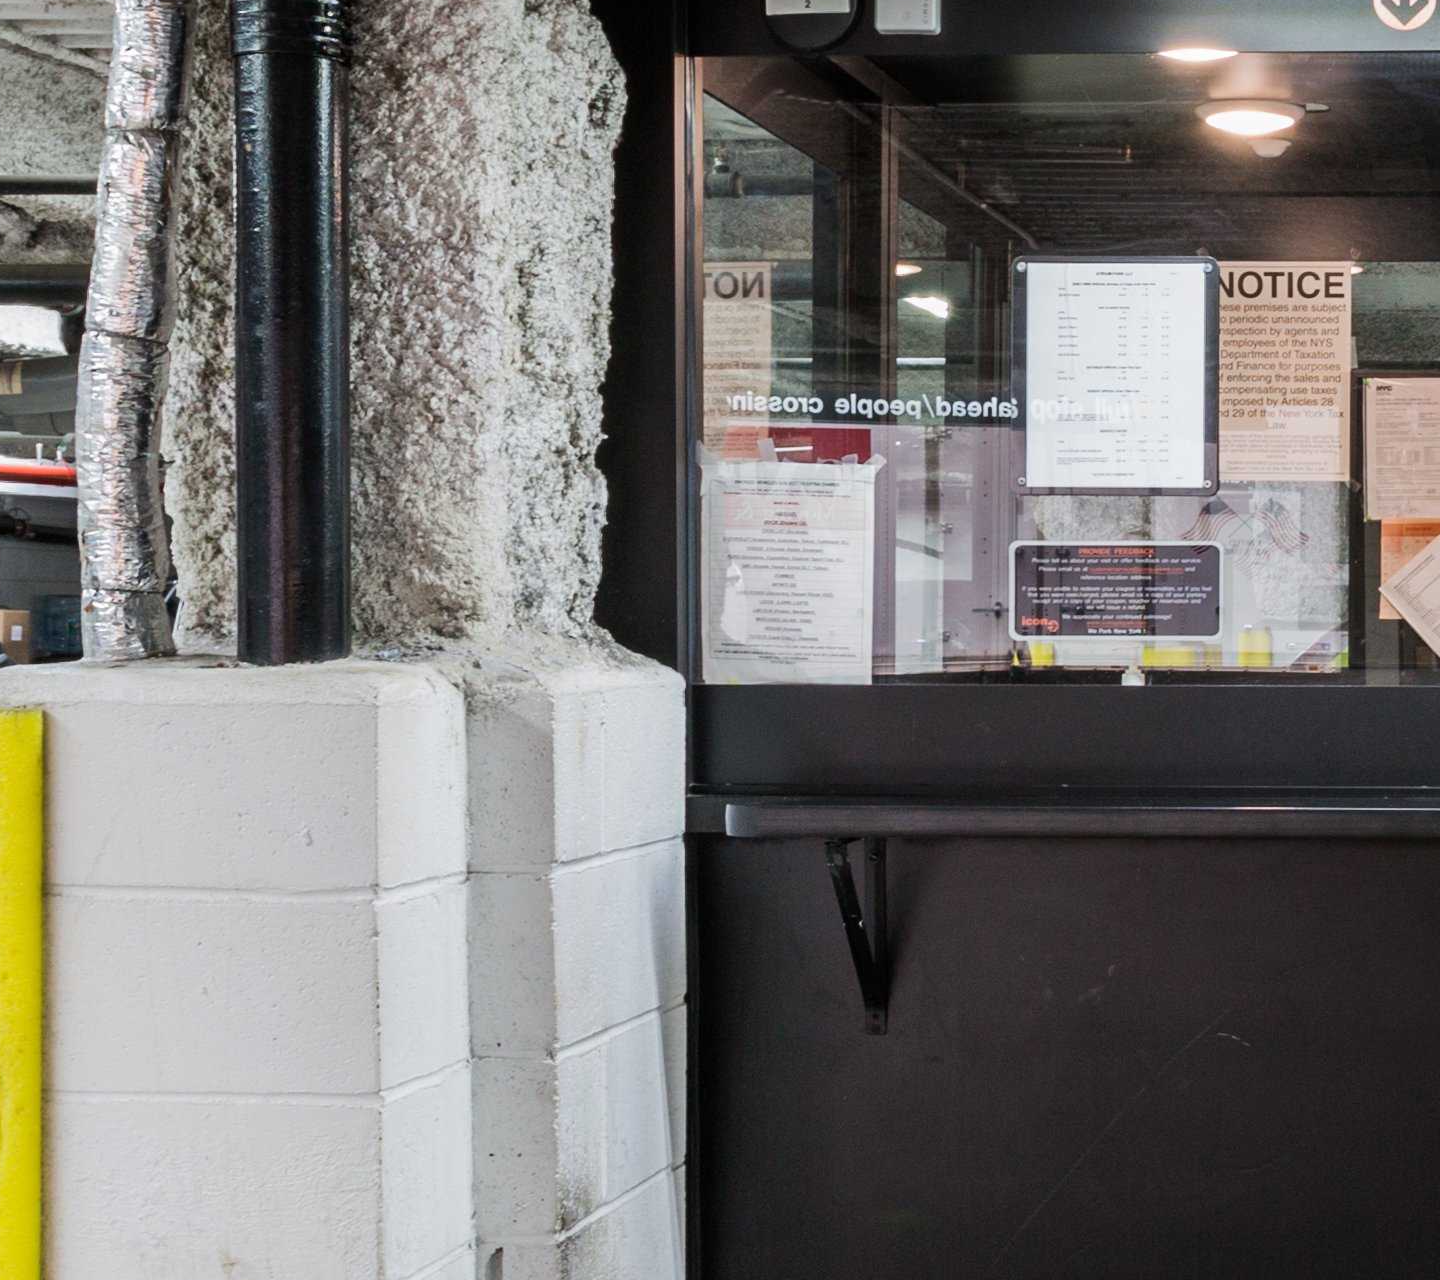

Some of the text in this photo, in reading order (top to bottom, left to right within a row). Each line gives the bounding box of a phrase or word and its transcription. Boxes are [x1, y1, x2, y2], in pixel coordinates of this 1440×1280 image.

[804, 0, 811, 8] 2
[1219, 271, 1345, 299] NOTICE
[1244, 304, 1288, 313] premises
[1311, 304, 1346, 313] subject
[1219, 315, 1339, 325] o periodic unannounced
[1219, 327, 1339, 337] nspection by agents and
[1223, 339, 1333, 349] employees of the NYS
[1221, 350, 1335, 361] Department of Taxation
[1219, 362, 1341, 372] nd Finance for purposes
[1227, 374, 1341, 385] enforcing the sales and
[1311, 387, 1337, 395] taxes
[1222, 398, 1334, 408] imposed by Articles 28
[1219, 409, 1229, 418] nd
[1232, 409, 1245, 418] 29
[1248, 409, 1258, 418] of
[1279, 409, 1301, 418] New
[1303, 409, 1323, 418] York
[1327, 409, 1344, 418] Tax
[1267, 421, 1286, 430] Law
[1022, 616, 1048, 626] icon
